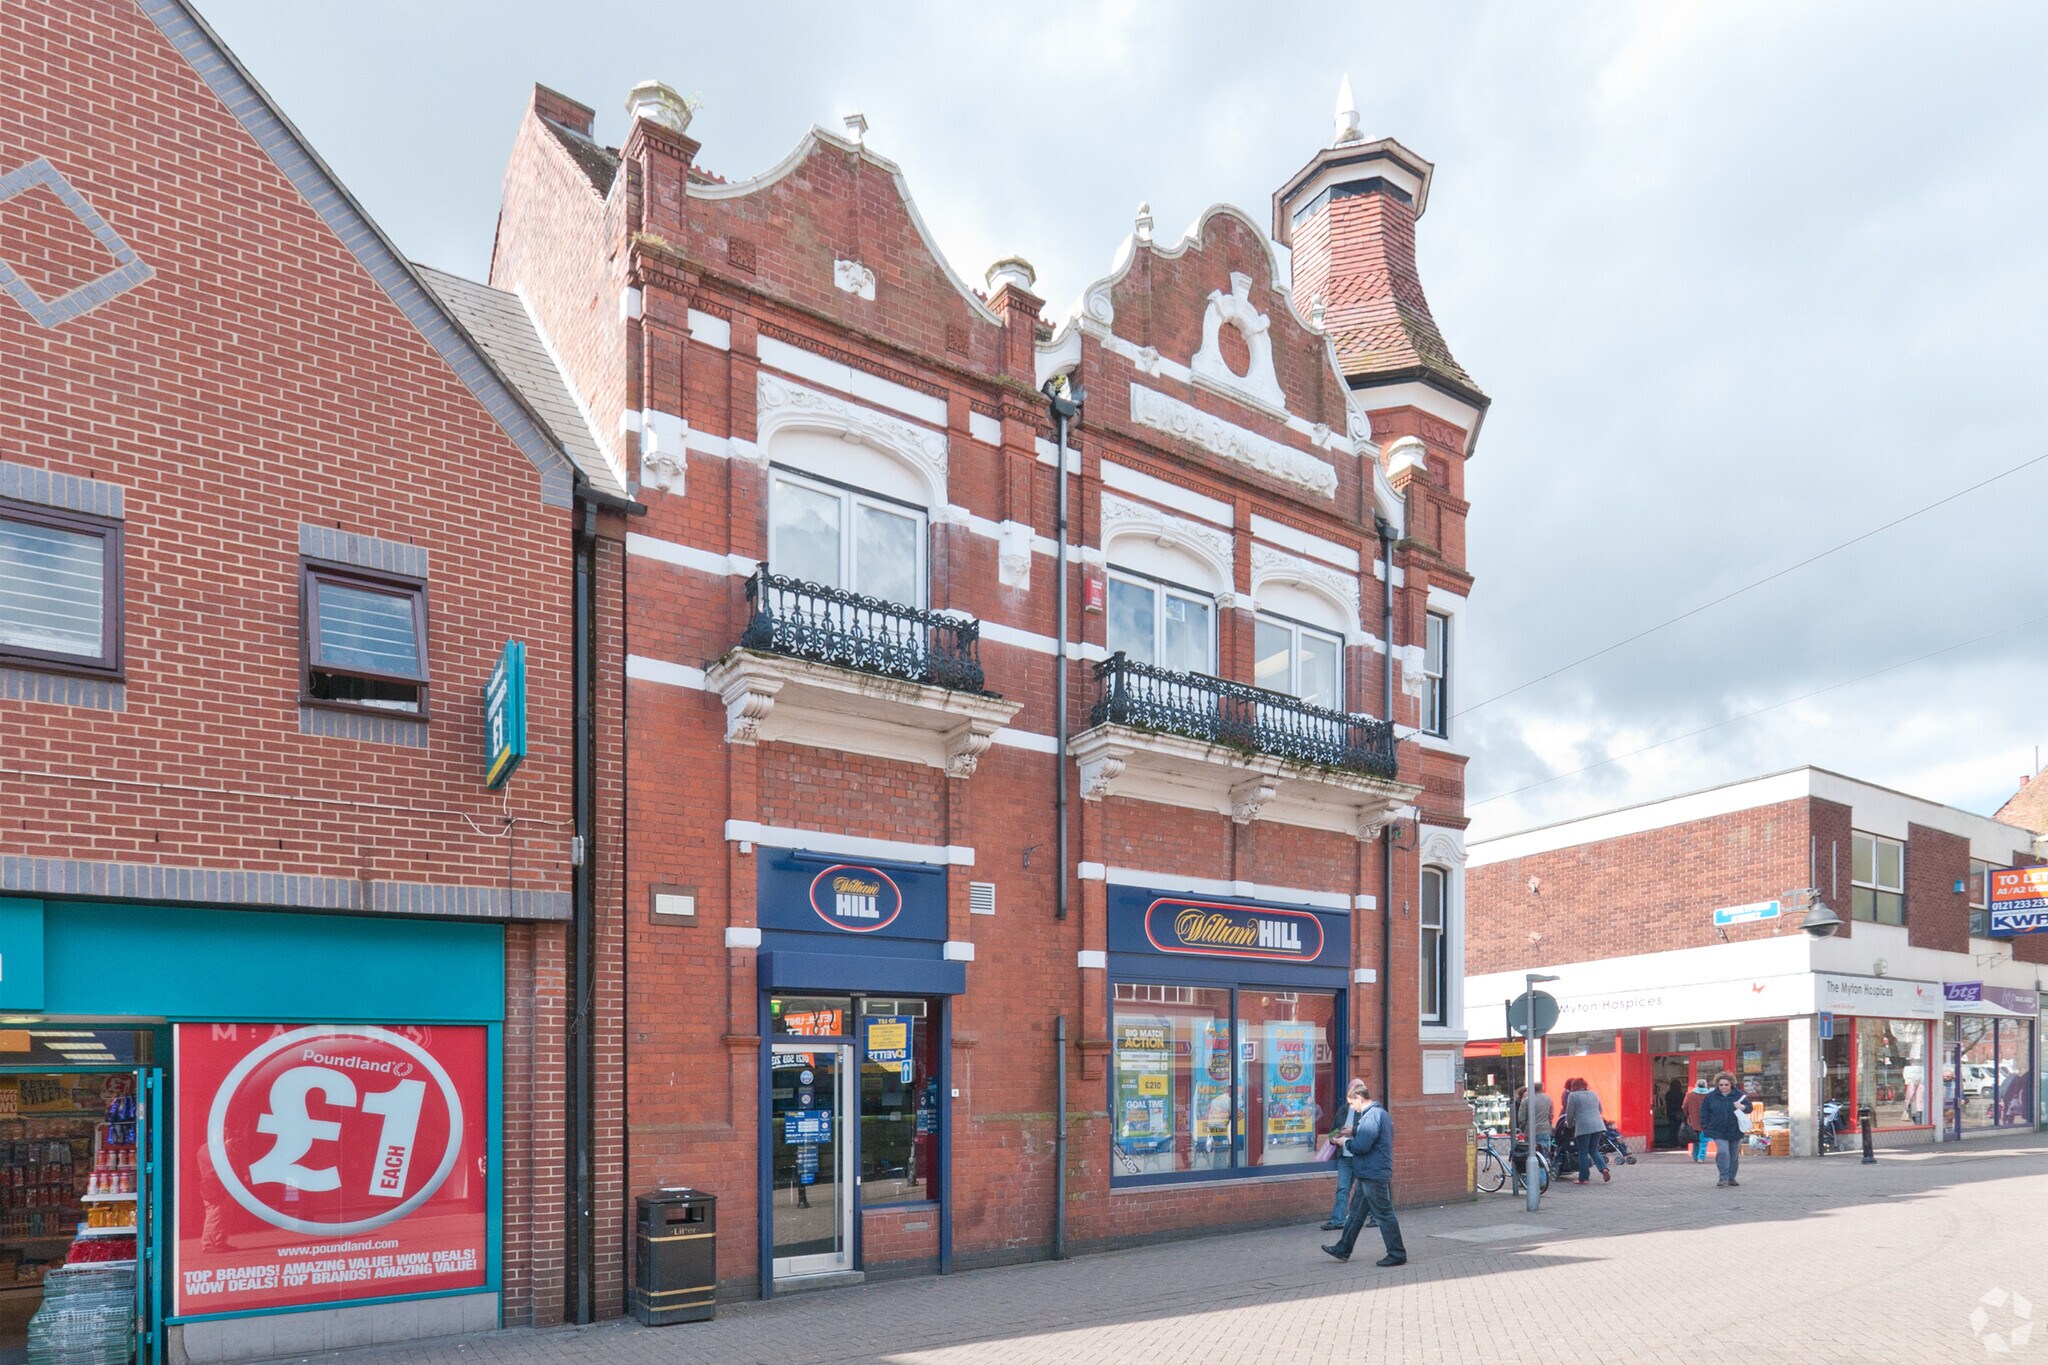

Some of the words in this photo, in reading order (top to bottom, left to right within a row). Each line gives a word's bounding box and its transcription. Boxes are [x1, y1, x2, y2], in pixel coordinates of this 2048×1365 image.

[832, 876, 880, 896] William
[1998, 874, 2019, 886] TO
[836, 893, 880, 918] HILL
[1992, 902, 2013, 910] 0121
[2014, 900, 2031, 909] 233
[1174, 908, 1260, 947] William
[1258, 919, 1302, 950] HILL
[1827, 980, 1839, 993] The
[1841, 982, 1863, 996] Myton
[1864, 984, 1894, 999] Hospices
[1948, 983, 1980, 1001] btg
[1560, 1003, 1598, 1016] Myton
[1602, 997, 1663, 1011] Hospices
[1124, 1037, 1165, 1049] ACTION
[1125, 1029, 1138, 1038] BIG
[1140, 1030, 1164, 1038] MATCH
[302, 1049, 391, 1073] Poundland
[1145, 1080, 1162, 1090] £210
[1126, 1100, 1147, 1108] GOAL
[1149, 1099, 1164, 1108] TIME
[248, 1066, 427, 1198] £1
[380, 1145, 406, 1189] EACH
[277, 1240, 399, 1257] www.poundland.com
[184, 1270, 213, 1284] TOP
[215, 1264, 280, 1281] BRANDS!
[283, 1258, 346, 1276] AMAZING
[348, 1255, 393, 1270] VALUE!
[396, 1252, 430, 1266] WOW
[432, 1248, 476, 1263] DEALS!
[186, 1281, 225, 1296] WOW
[227, 1276, 278, 1292] DEALS!
[282, 1273, 308, 1287] TOP
[311, 1268, 372, 1285] BRANDS!
[374, 1264, 433, 1279] AMAZING
[435, 1258, 477, 1273] VALUE!
